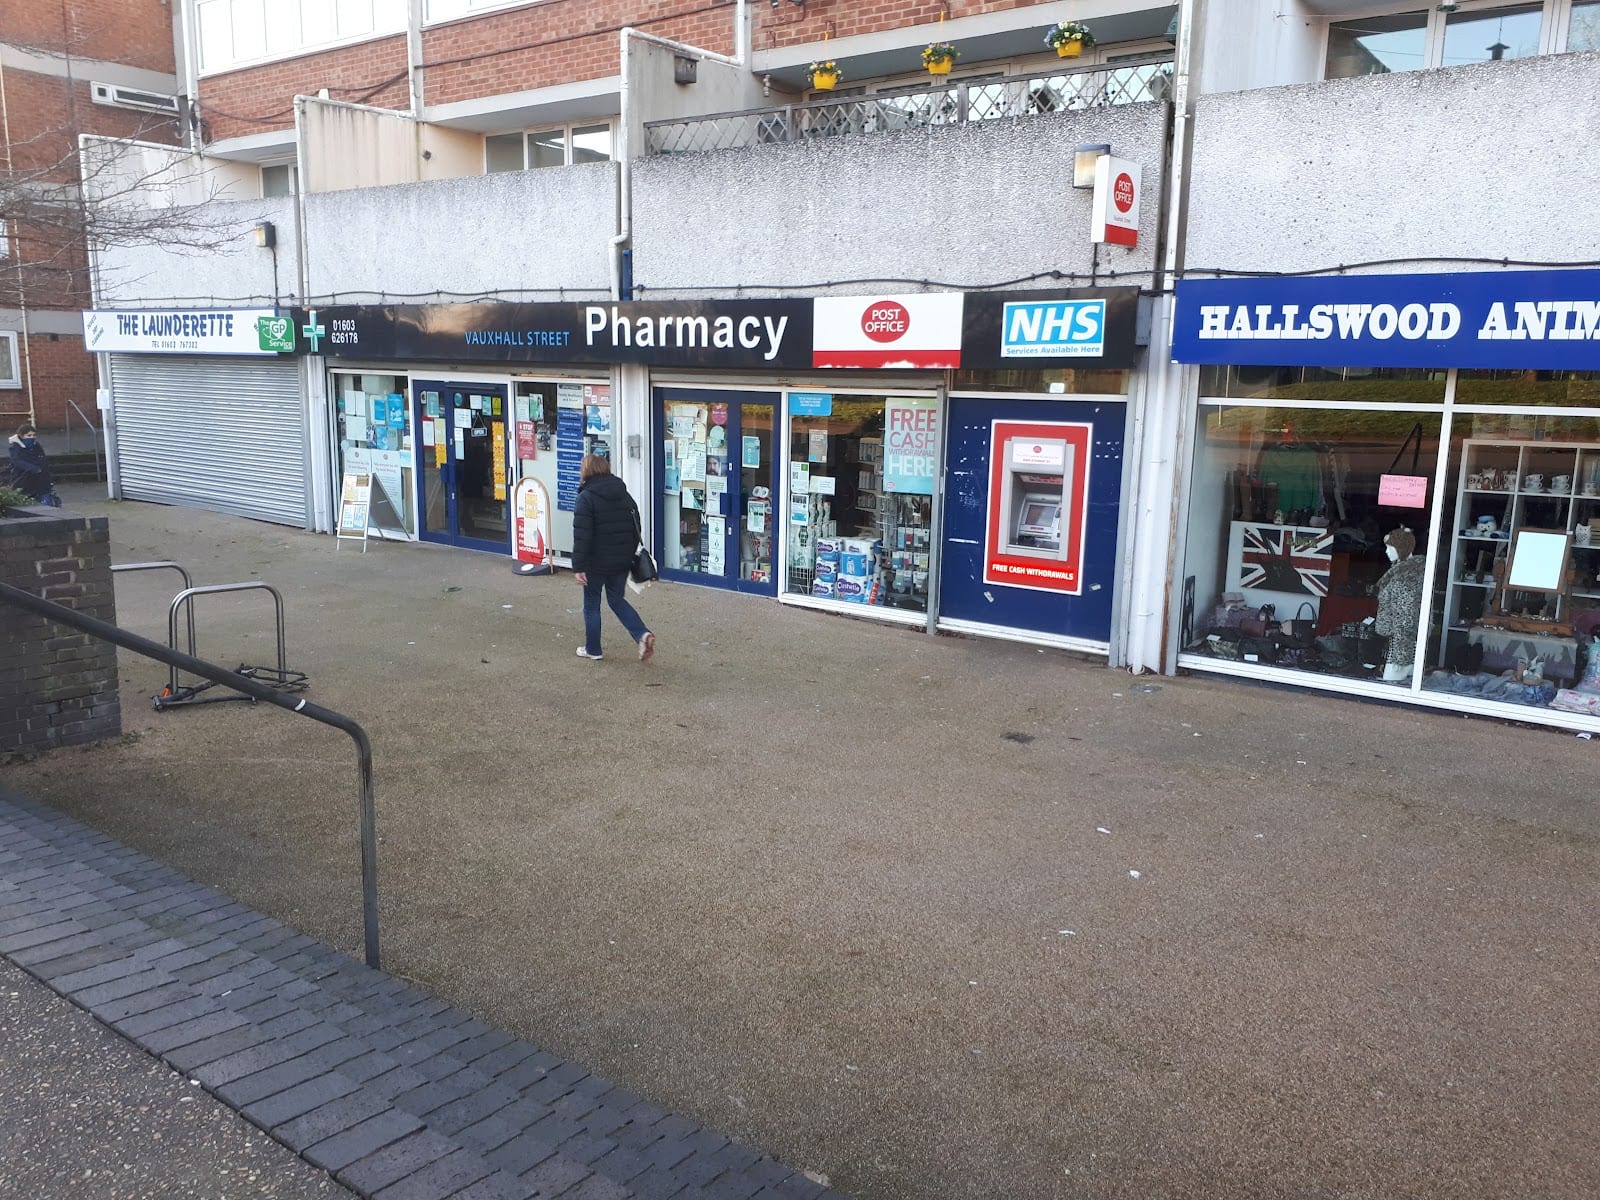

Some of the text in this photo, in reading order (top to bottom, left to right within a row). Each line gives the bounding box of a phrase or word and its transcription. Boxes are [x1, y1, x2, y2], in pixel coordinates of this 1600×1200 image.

[1118, 180, 1131, 192] POST
[1115, 191, 1132, 204] OFFICE
[872, 309, 901, 321] POST
[1199, 303, 1462, 339] HALLSWOOD
[116, 314, 138, 336] THE
[142, 313, 234, 338] LAUNDERETTE
[271, 323, 286, 334] GP
[333, 320, 355, 331] 01603
[865, 320, 904, 333] OFFICE
[1008, 305, 1100, 342] NHS
[331, 332, 359, 344] 626178
[464, 331, 570, 346] VAUXHALL STREET
[585, 306, 788, 361] Pharmacy
[1006, 345, 1100, 355] Services Available Here
[890, 408, 937, 433] FREE
[889, 431, 936, 450] CASH
[888, 455, 935, 478] HERE
[992, 563, 1074, 580] FREE CASH WITHDRAWALS
